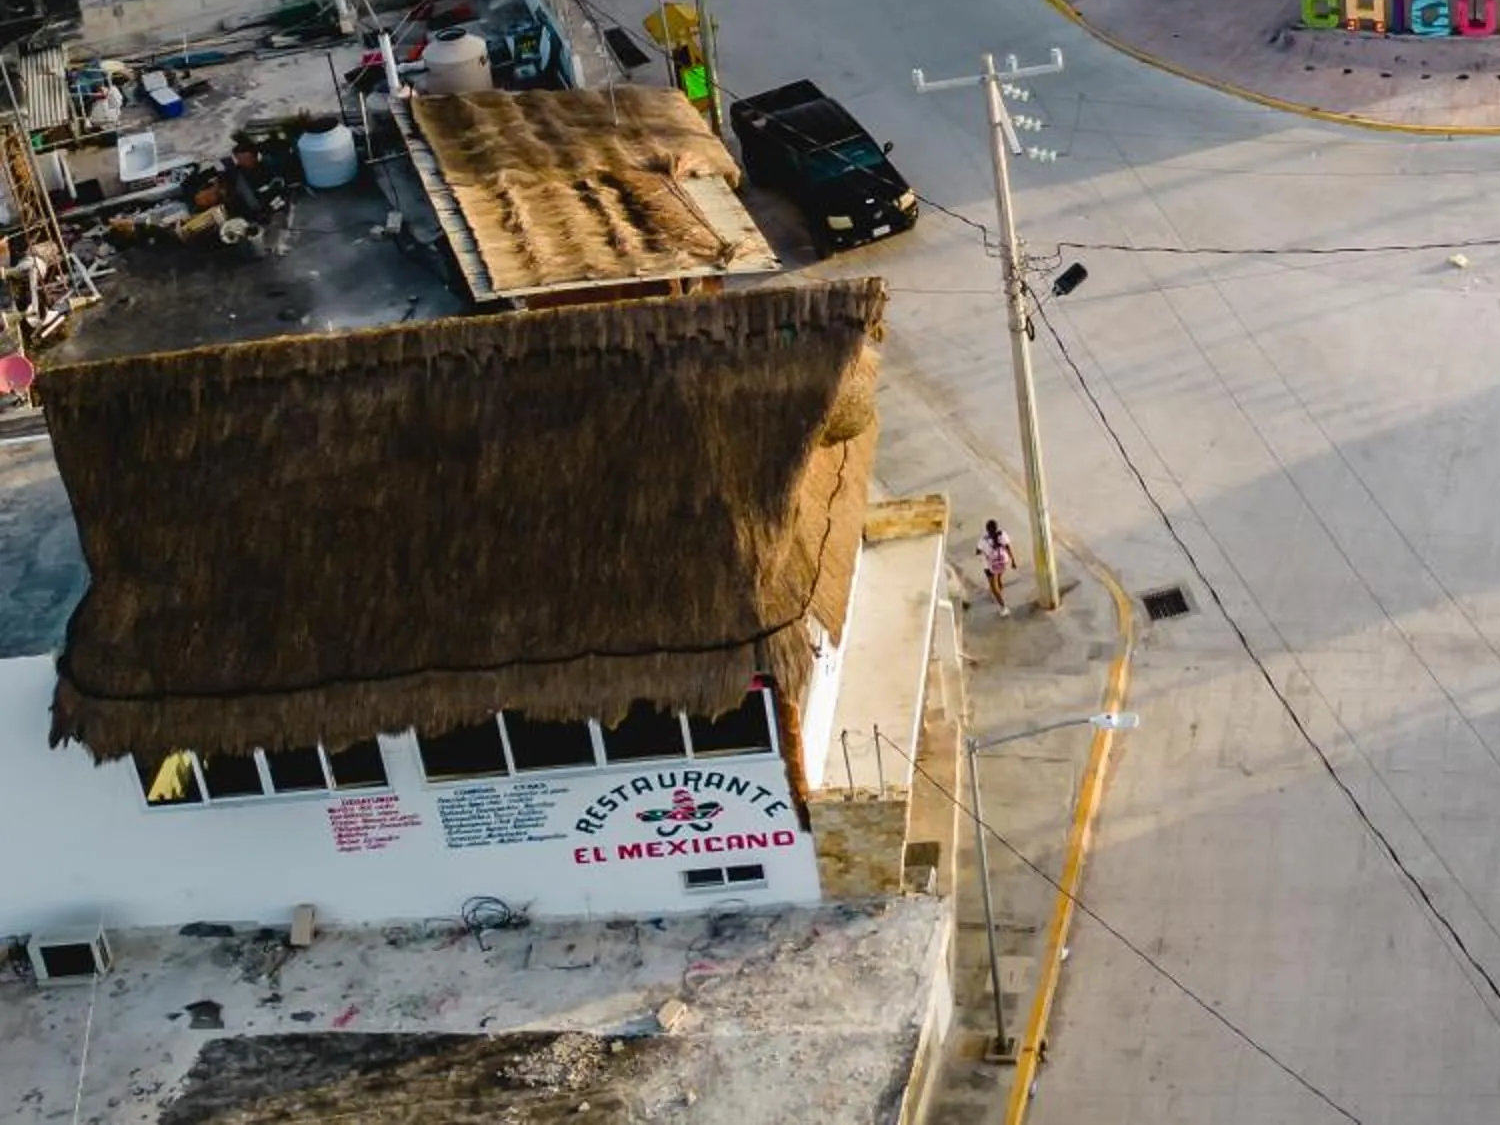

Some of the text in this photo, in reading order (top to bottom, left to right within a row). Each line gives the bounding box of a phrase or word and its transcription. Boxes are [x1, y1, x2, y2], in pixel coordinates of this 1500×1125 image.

[575, 770, 789, 835] RESTAURANTE
[574, 830, 795, 864] EL MEXICANO
